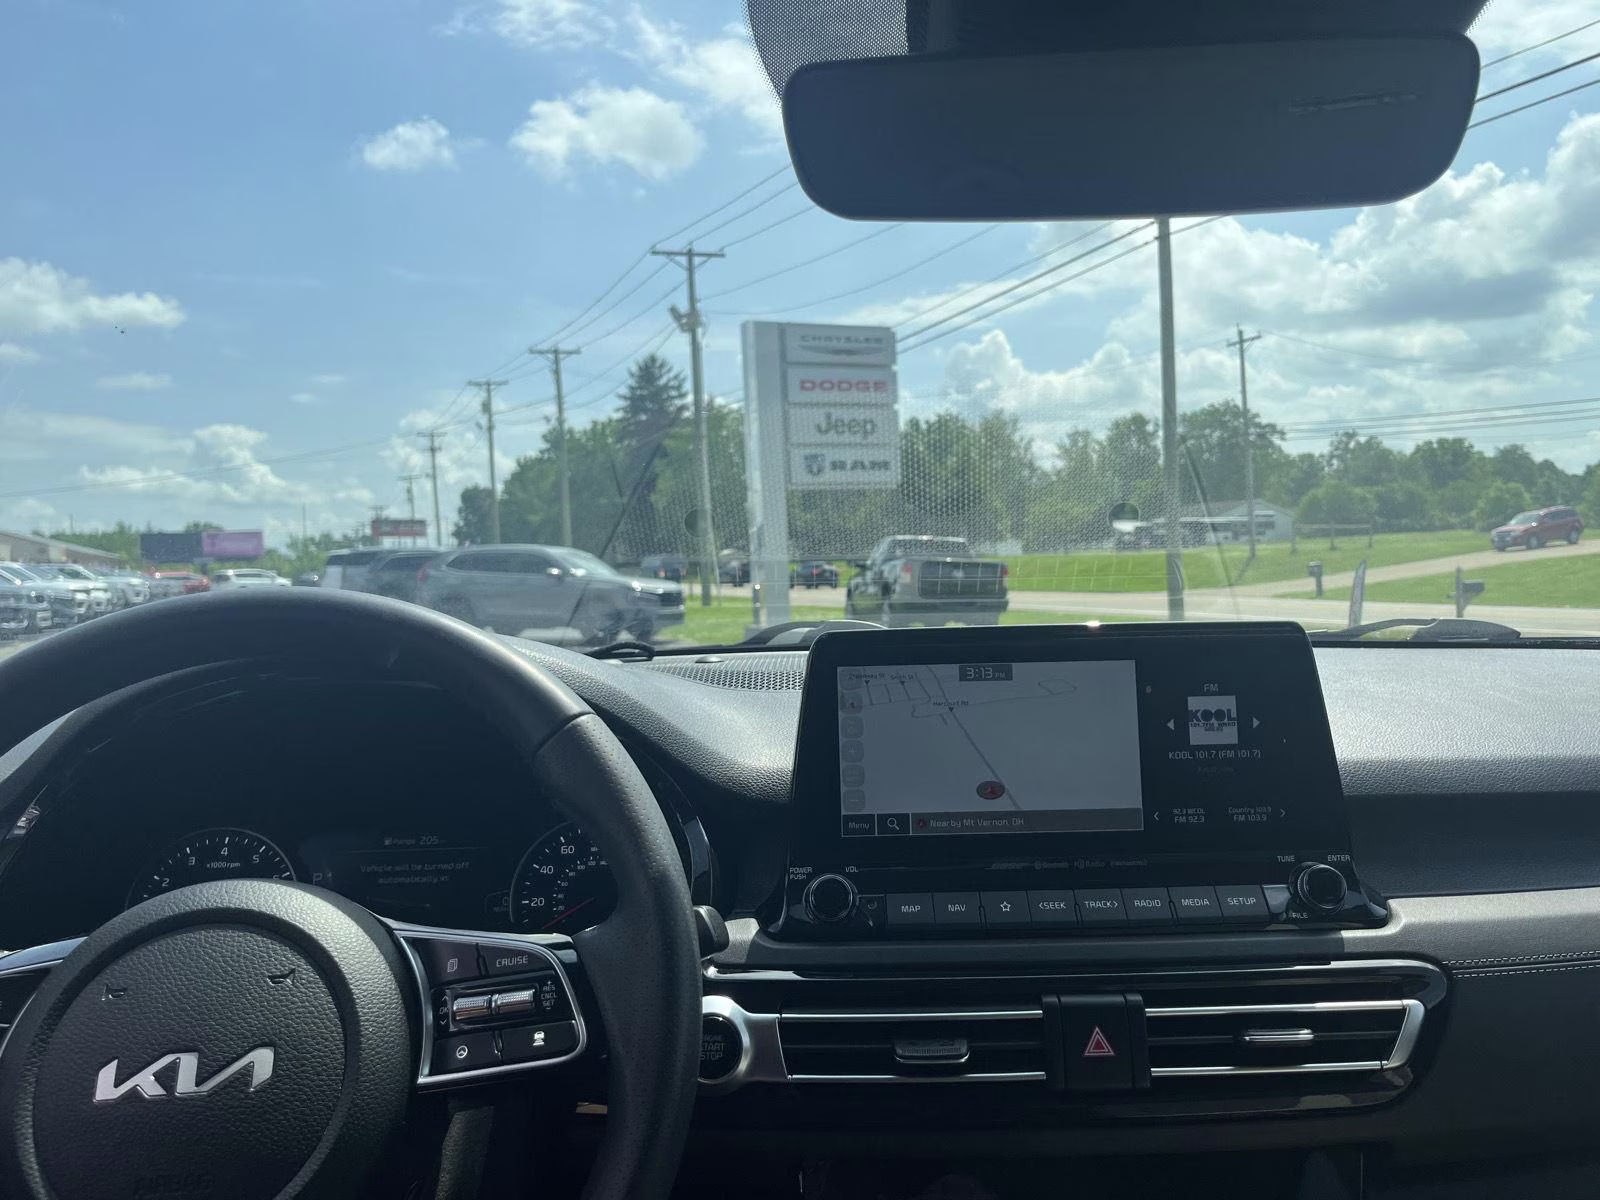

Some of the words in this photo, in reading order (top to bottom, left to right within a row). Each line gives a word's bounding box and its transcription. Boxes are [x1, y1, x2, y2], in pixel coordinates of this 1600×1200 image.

[800, 334, 883, 344] CHRYSLER
[799, 379, 887, 392] DODGE
[816, 411, 876, 438] Jeep
[829, 459, 890, 471] RAM
[966, 667, 993, 680] 3:13
[1203, 683, 1219, 693] FM
[1188, 709, 1237, 722] KOOL
[1168, 751, 1193, 760] KOOL
[1195, 751, 1216, 759] 101.7
[1218, 750, 1235, 760] (FM
[1237, 749, 1261, 759] 101.7)
[930, 818, 961, 828] Nearby
[963, 819, 975, 827] Mt
[1012, 817, 1025, 826] OH
[1188, 815, 1205, 823] 92.3
[848, 822, 870, 830] Menu
[419, 835, 439, 846] 205
[220, 846, 229, 857] 4
[560, 845, 575, 855] 60
[187, 856, 196, 866] 3
[252, 855, 260, 864] 5
[1276, 855, 1295, 863] TUNE
[1327, 854, 1350, 862] ENTER
[540, 865, 554, 875] 40
[789, 866, 812, 874] POWER
[161, 878, 170, 888] 2
[530, 897, 545, 907] 20
[1134, 899, 1161, 907] RADIO
[1181, 898, 1210, 906] MEDIA
[1227, 896, 1257, 905] SETUP
[901, 904, 921, 913] MAP
[948, 903, 966, 912] NAV
[496, 955, 529, 968] CRUISE
[93, 1046, 275, 1102] KIA
